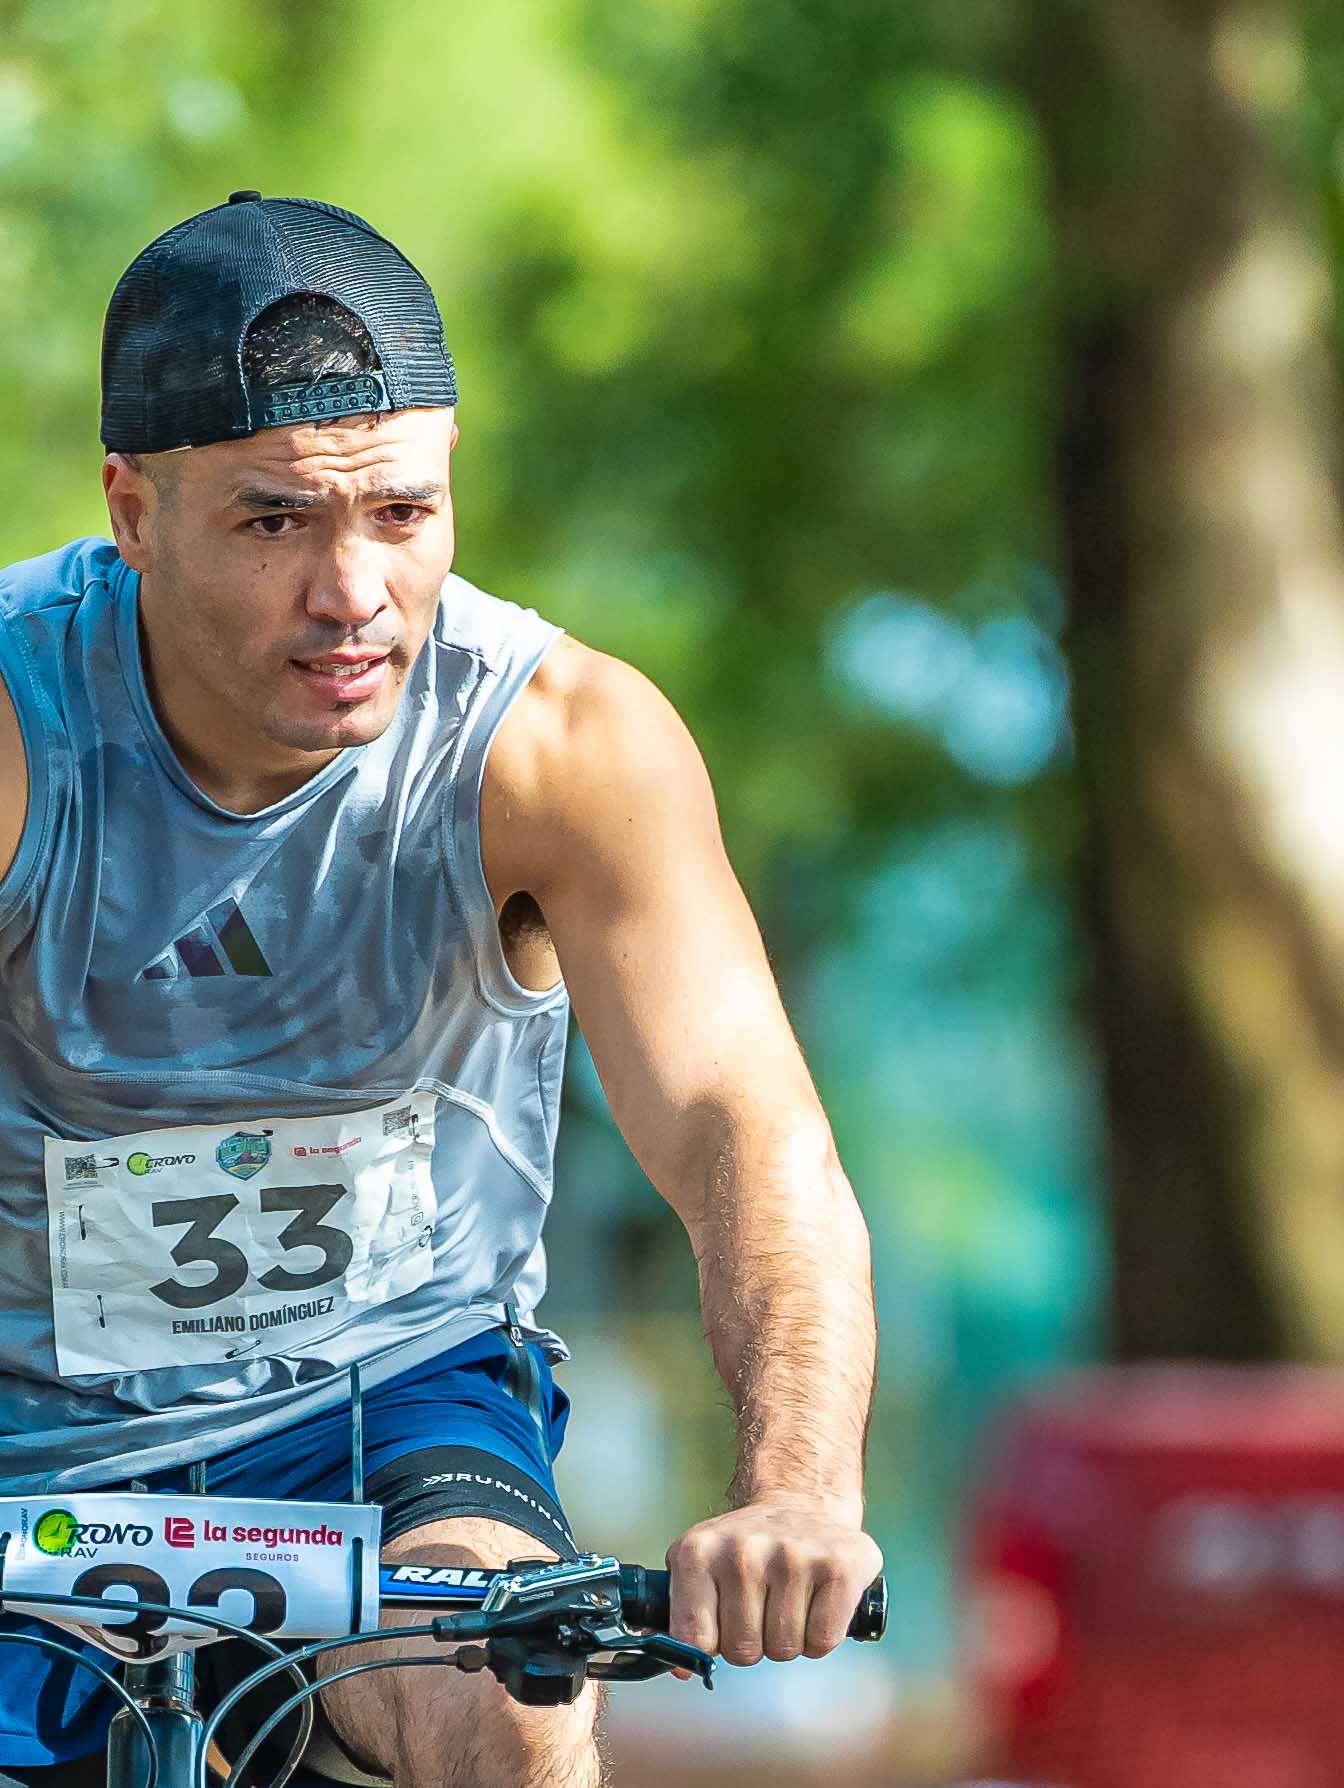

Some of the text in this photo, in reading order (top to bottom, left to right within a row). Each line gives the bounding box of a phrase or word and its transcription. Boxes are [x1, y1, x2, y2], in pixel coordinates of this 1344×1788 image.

[148, 1184, 354, 1309] 33
[171, 1296, 335, 1335] EMILIANO DOMÍNGUEZ
[203, 1519, 344, 1549] la segunda
[60, 1547, 98, 1559] RAV
[245, 1552, 300, 1562] SEGUROS
[392, 1565, 494, 1588] RAL
